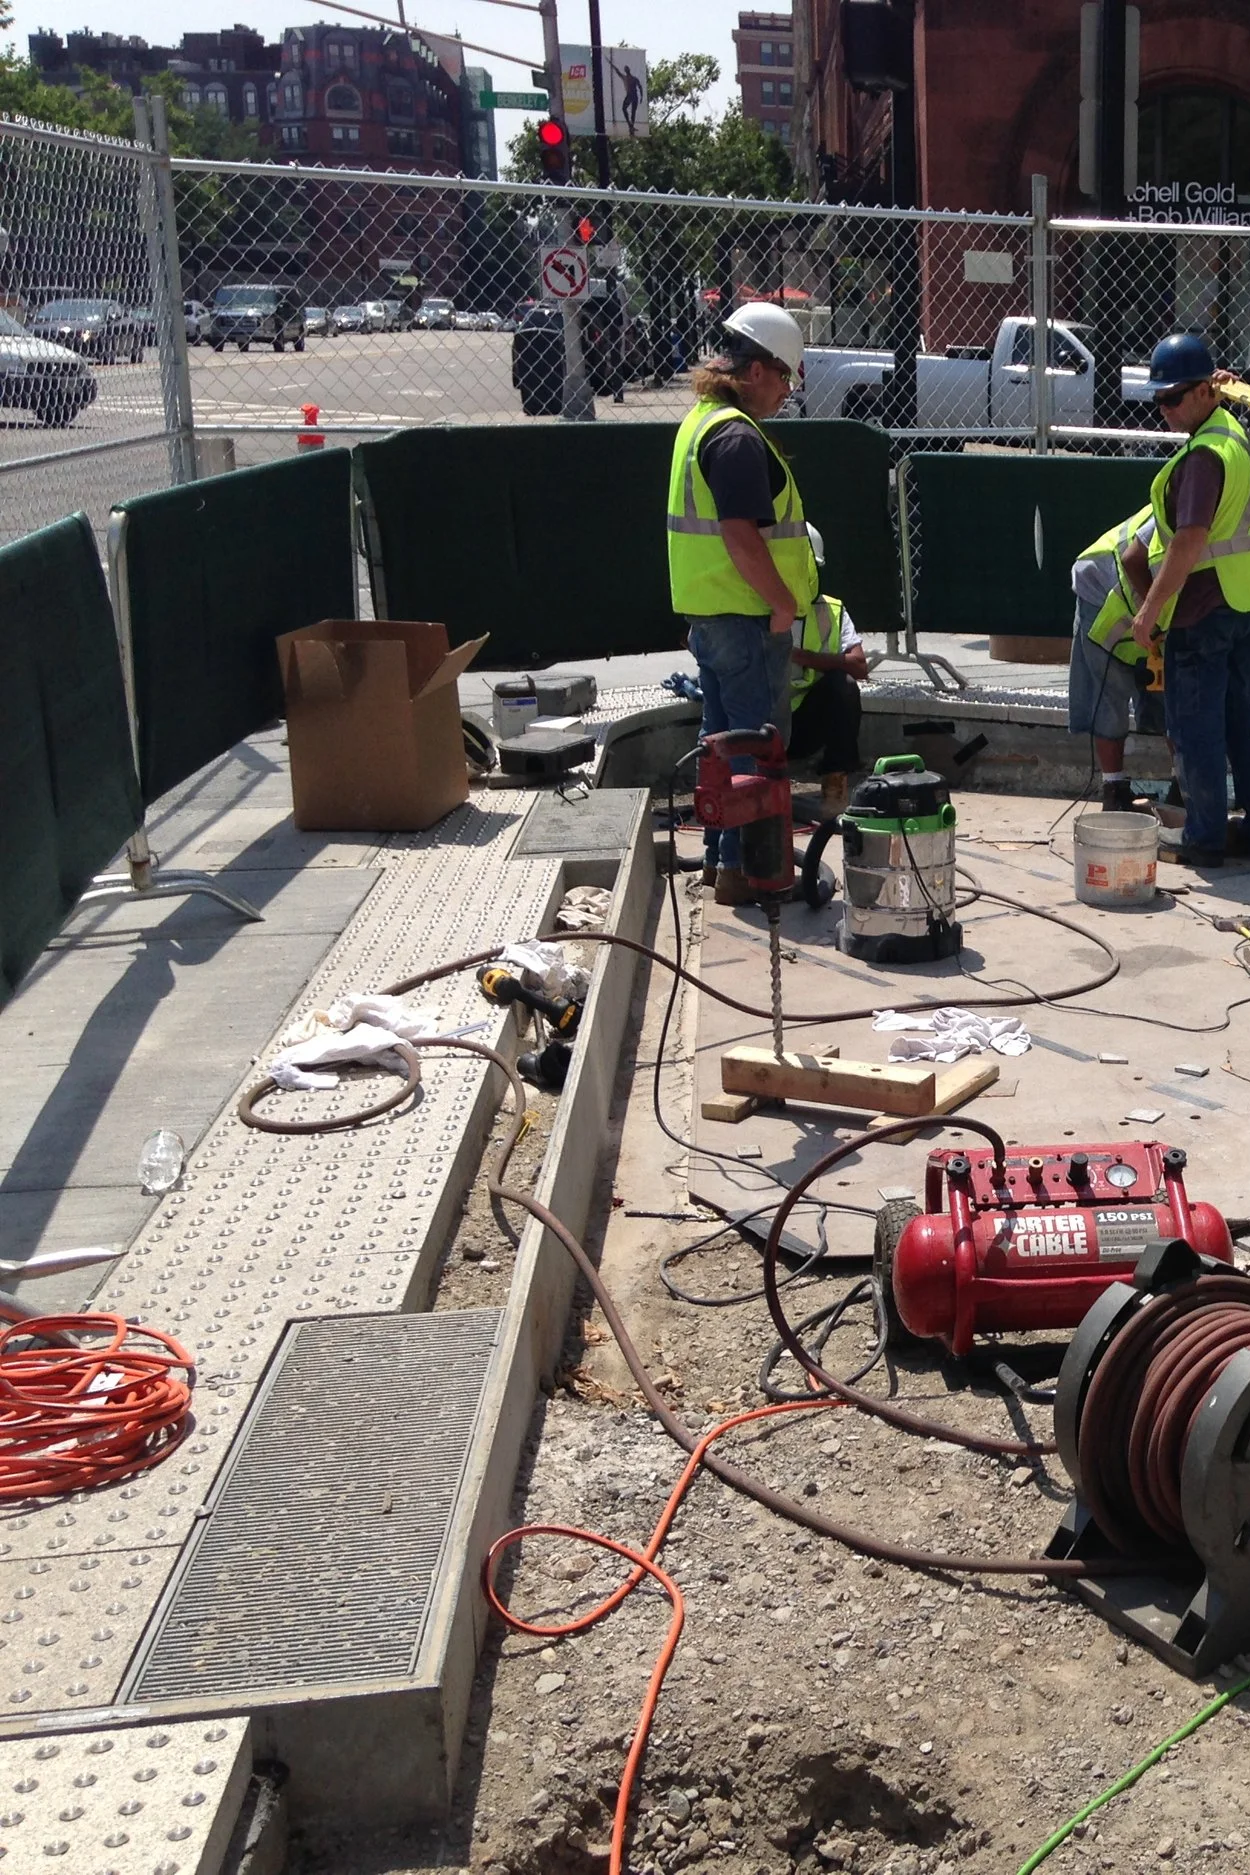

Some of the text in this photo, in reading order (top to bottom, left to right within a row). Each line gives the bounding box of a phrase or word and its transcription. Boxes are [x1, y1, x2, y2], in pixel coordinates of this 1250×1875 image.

[1127, 181, 1235, 203] chell Gold
[993, 1215, 1086, 1234] PORTER
[1097, 1212, 1154, 1223] 150 PSI
[1017, 1232, 1088, 1257] CABLE
